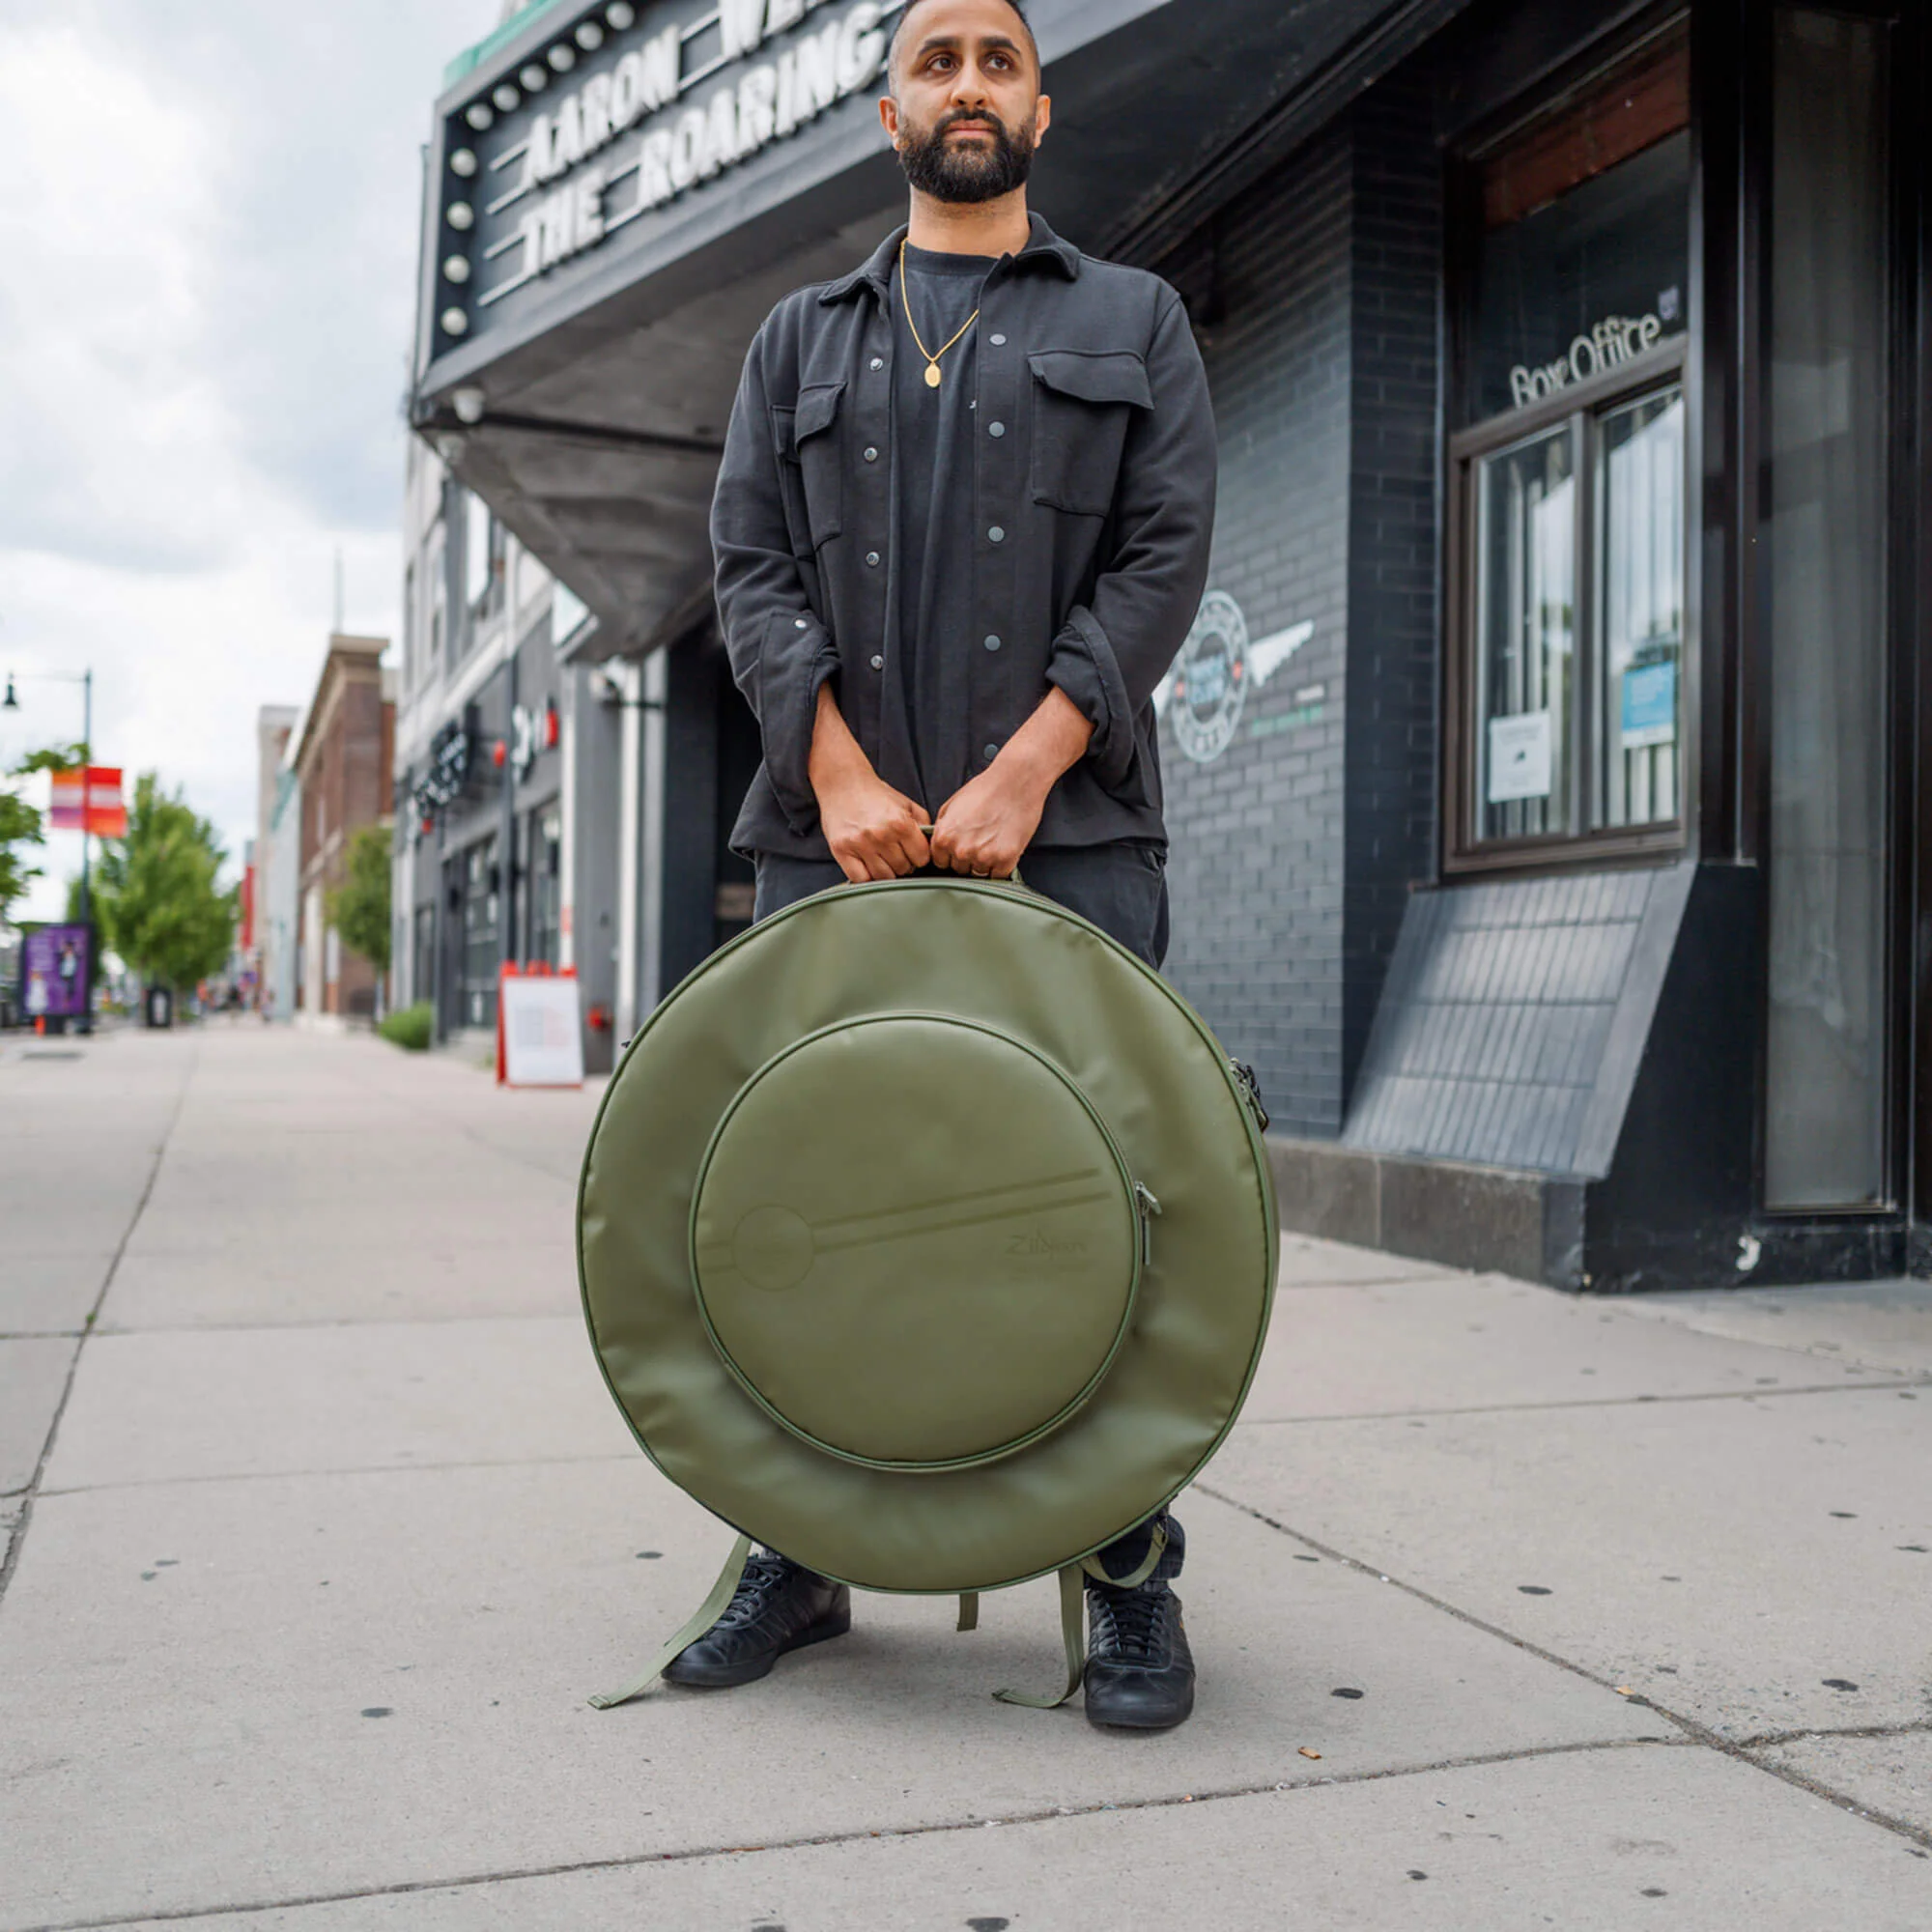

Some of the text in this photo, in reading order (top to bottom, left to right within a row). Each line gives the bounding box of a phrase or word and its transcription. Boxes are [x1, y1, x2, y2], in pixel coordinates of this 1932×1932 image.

[519, 3, 886, 278] THE ROARING
[522, 24, 680, 188] AARON
[1569, 313, 1661, 382] Office
